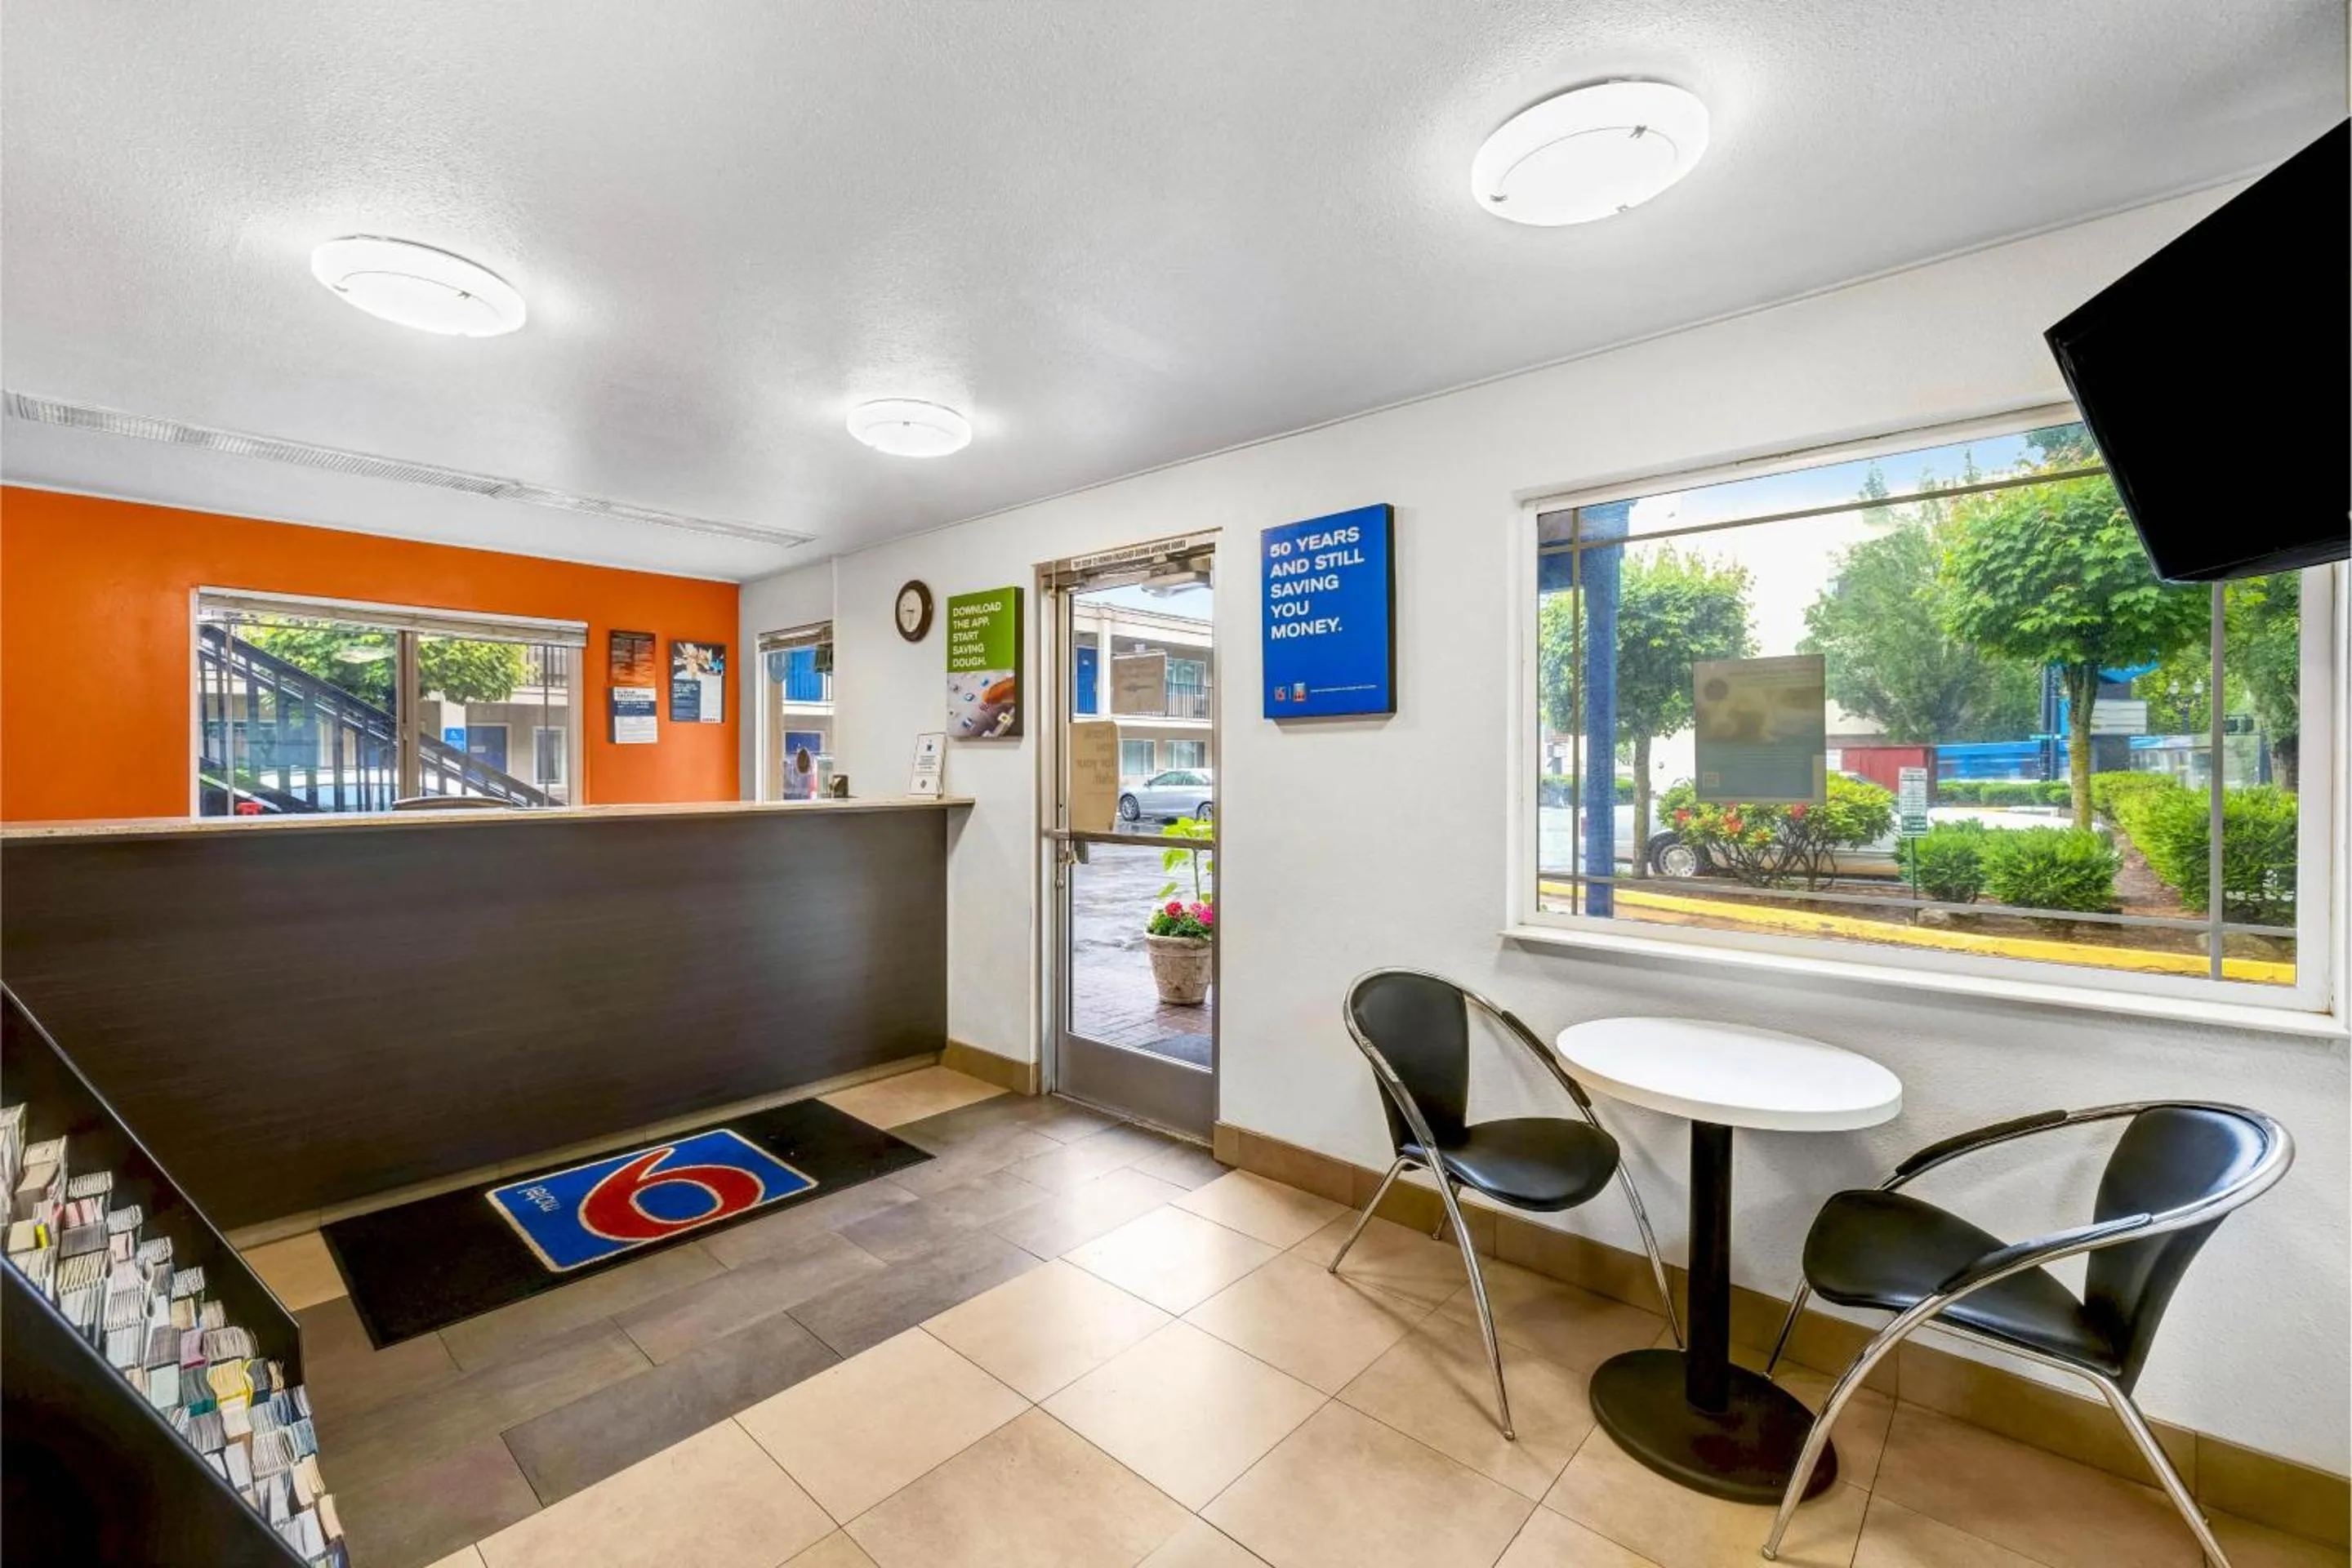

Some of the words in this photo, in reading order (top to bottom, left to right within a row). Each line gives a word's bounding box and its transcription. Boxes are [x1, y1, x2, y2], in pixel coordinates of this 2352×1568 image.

[1270, 542, 1291, 557] 50
[1296, 527, 1360, 551] YEARS
[1270, 559, 1309, 578] AND
[1315, 549, 1365, 570] STILL
[1271, 575, 1339, 599] SAVING
[953, 602, 1001, 617] DOWNLOAD
[1271, 601, 1309, 618] YOU
[953, 619, 969, 629] THE
[972, 617, 990, 626] APP.
[1271, 617, 1343, 639] MONEY.
[953, 630, 978, 642] START
[953, 643, 984, 655] SAVING
[953, 657, 987, 667] DOUGH.
[578, 1147, 765, 1242] 6
